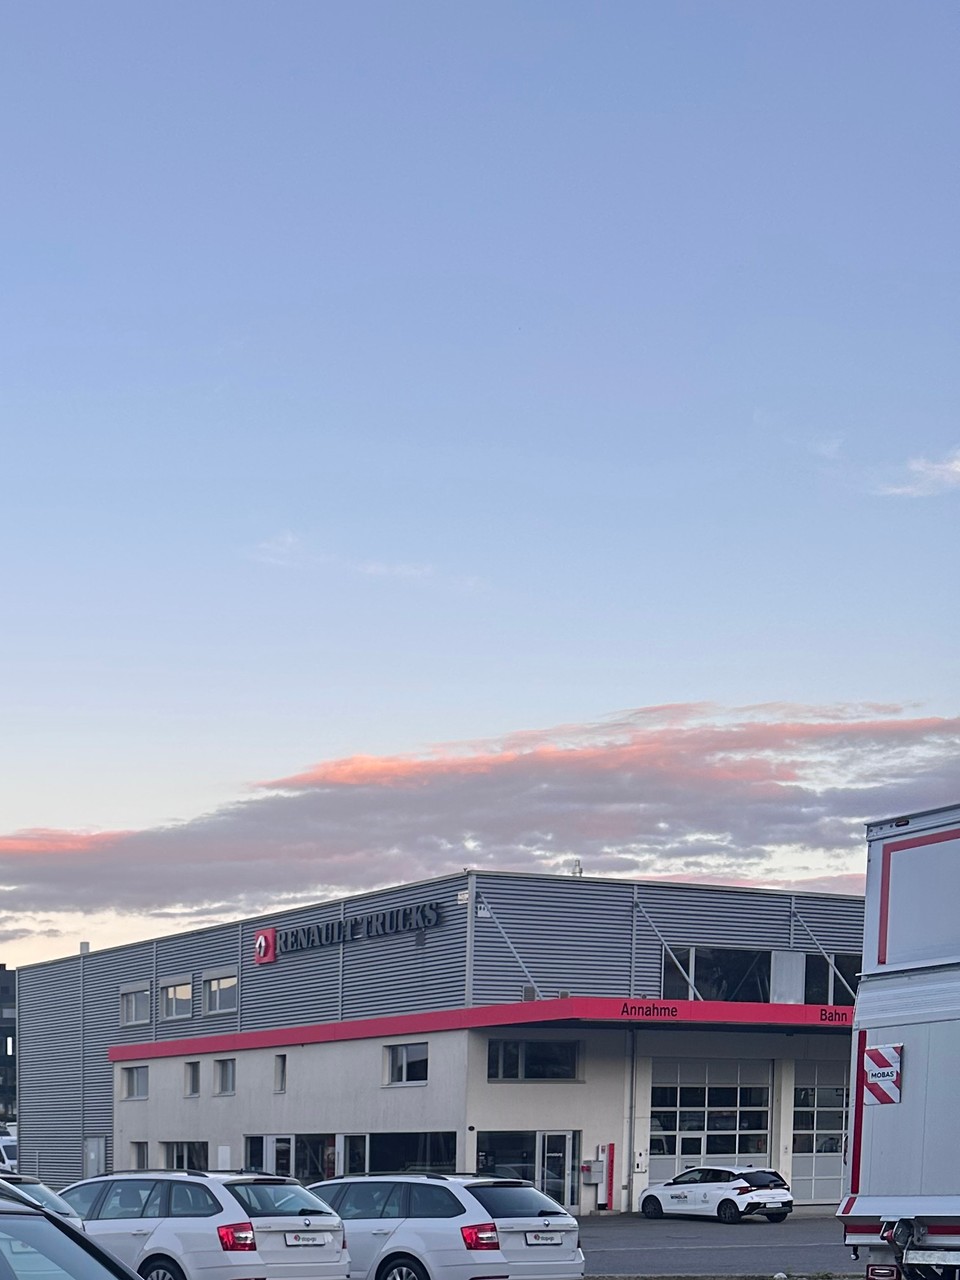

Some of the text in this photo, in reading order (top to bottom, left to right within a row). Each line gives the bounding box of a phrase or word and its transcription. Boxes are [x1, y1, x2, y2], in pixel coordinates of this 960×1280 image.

[276, 902, 440, 954] RENAULT TRUCKS
[621, 1003, 677, 1017] Annahme
[820, 1009, 847, 1022] Bahn
[871, 1071, 895, 1079] MOBAS
